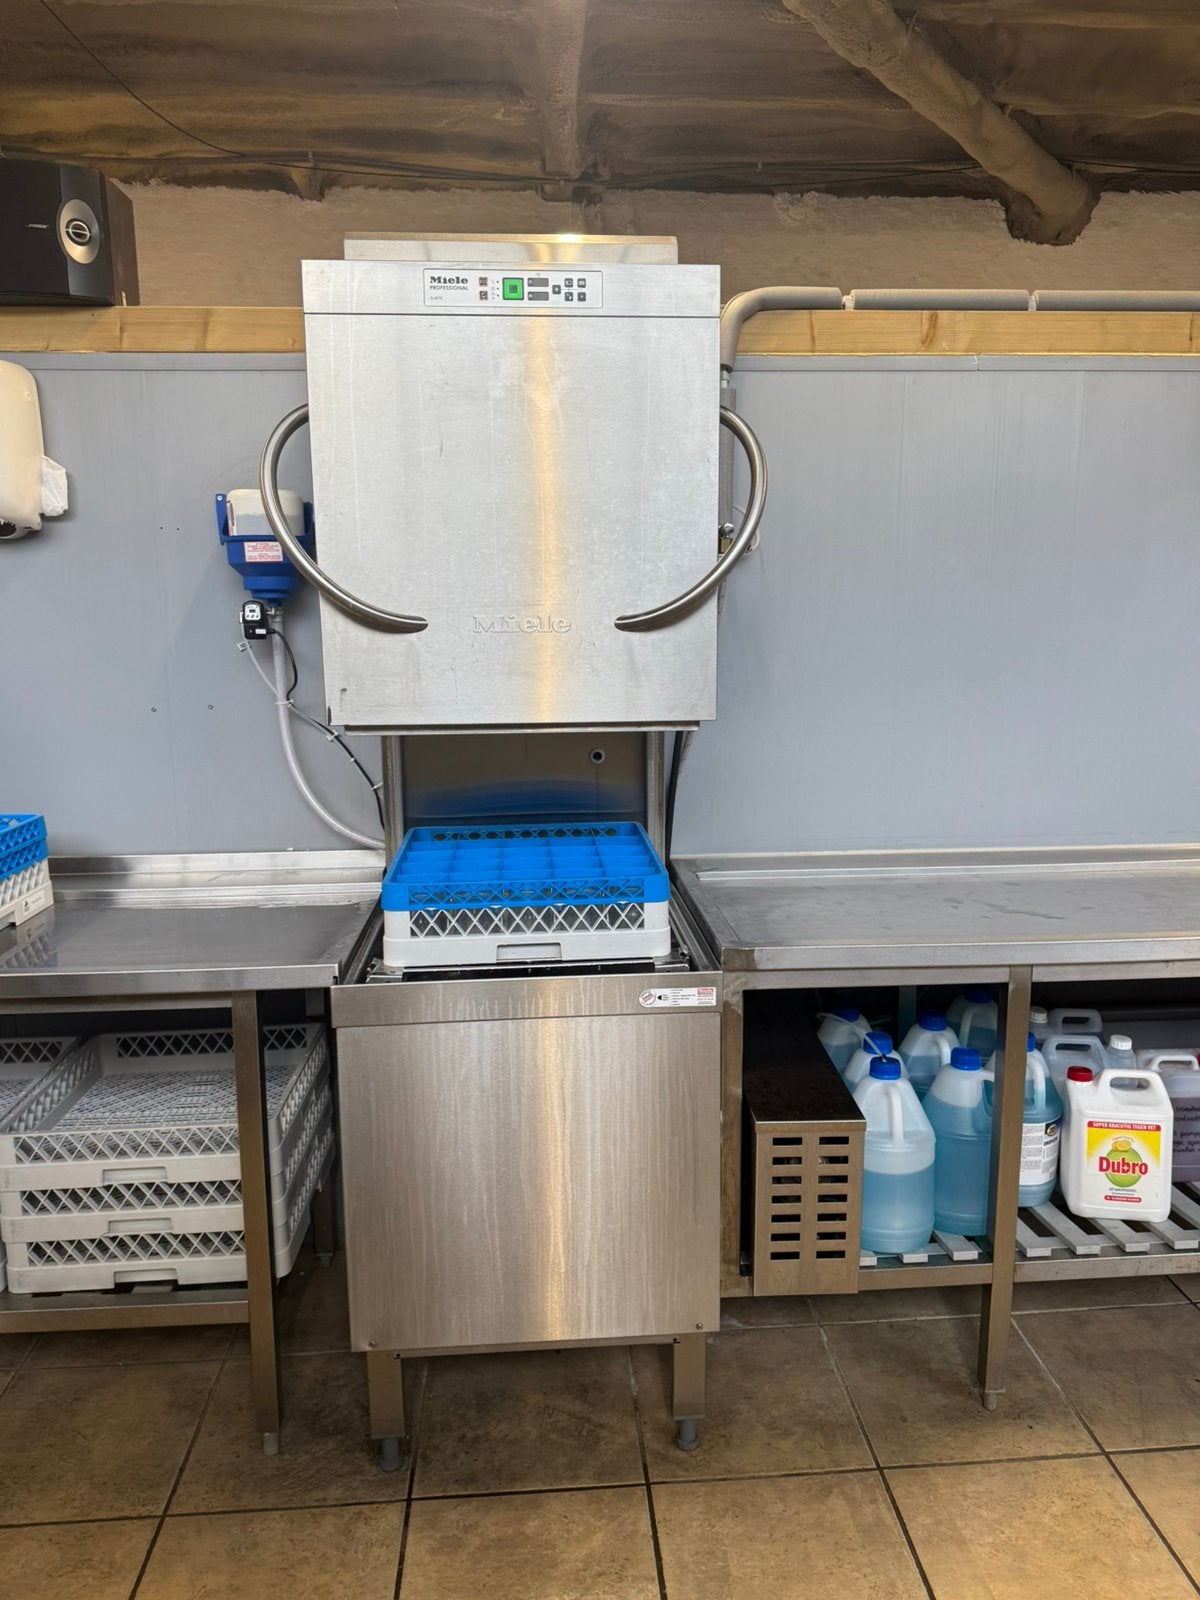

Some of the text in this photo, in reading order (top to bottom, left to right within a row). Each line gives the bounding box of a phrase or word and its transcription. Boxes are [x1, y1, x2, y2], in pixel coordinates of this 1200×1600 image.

[430, 276, 469, 284] Miele
[472, 614, 572, 634] Miele
[1098, 1156, 1148, 1175] Dubro
